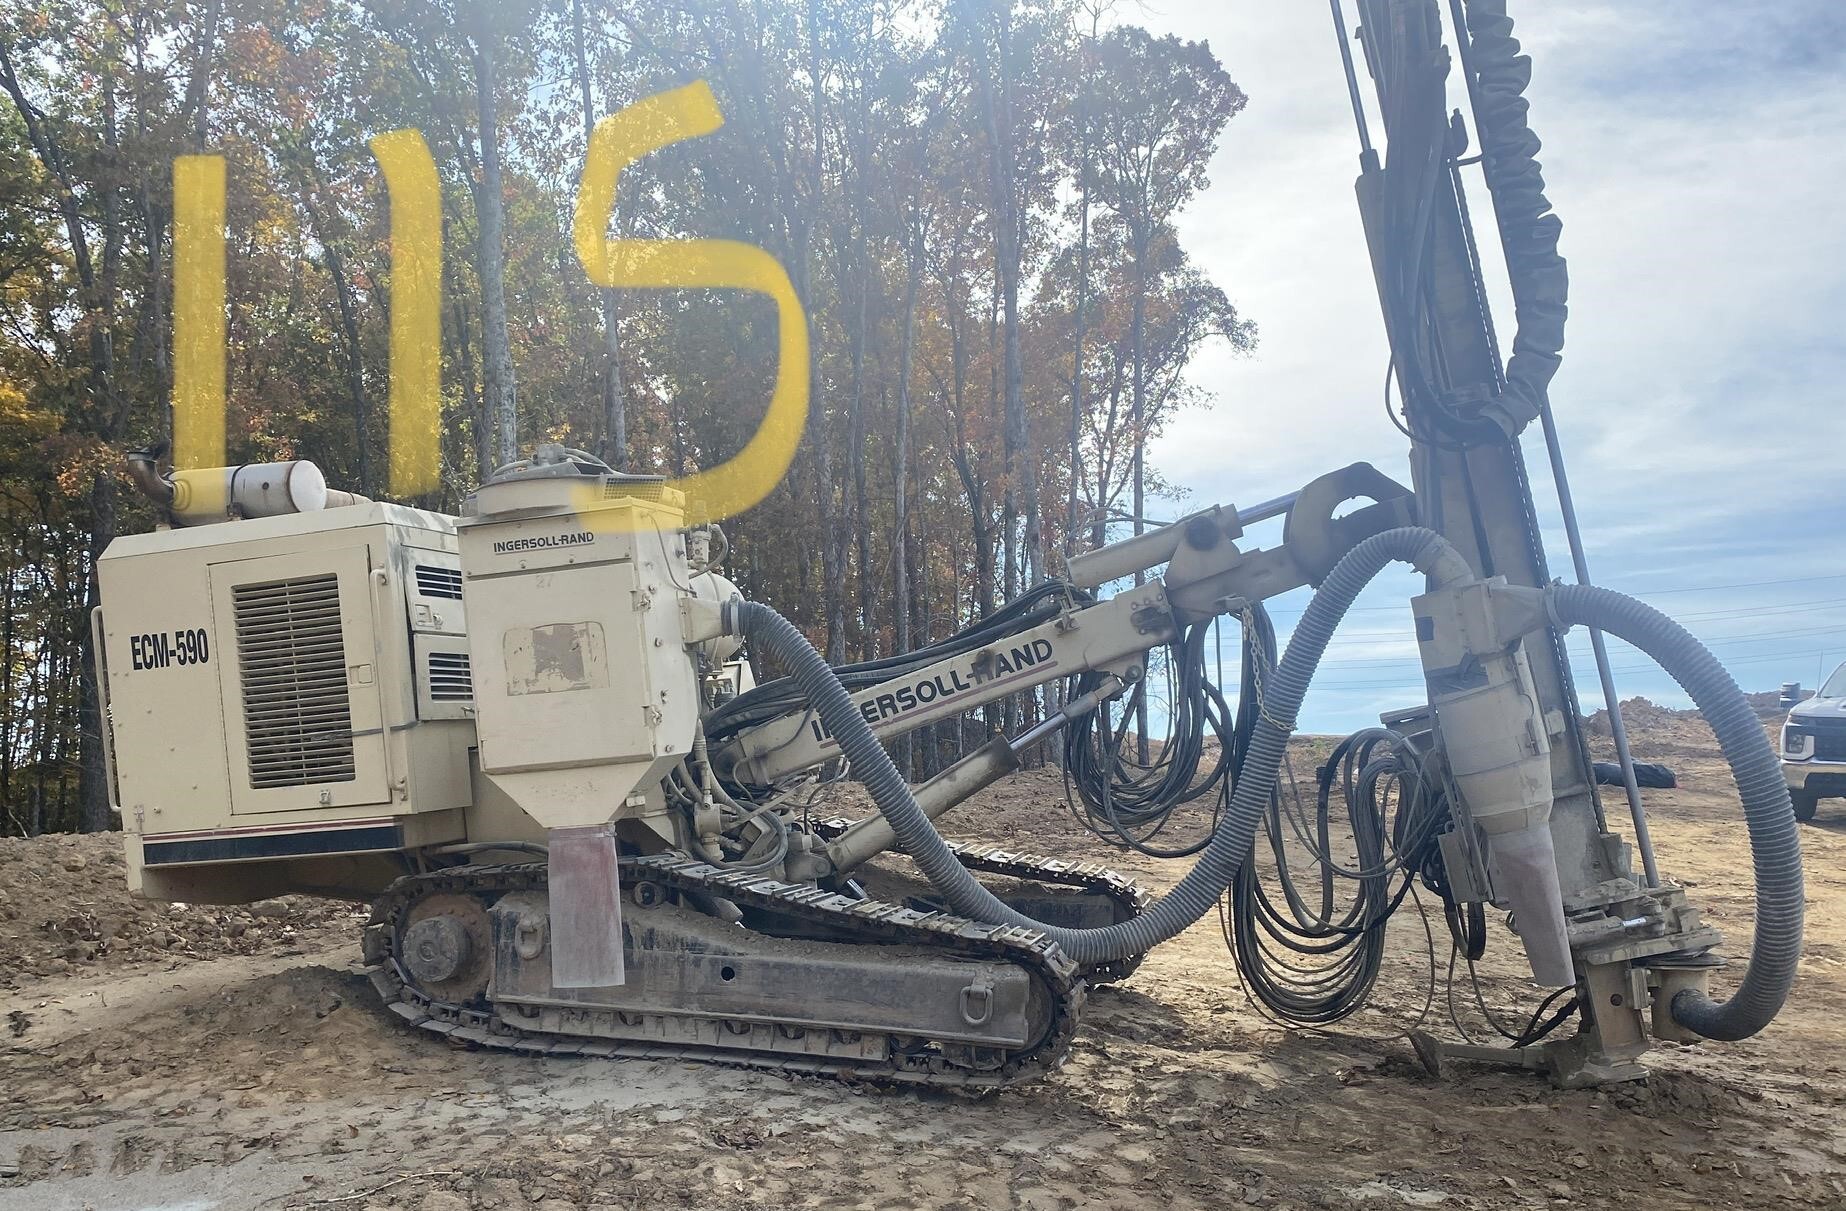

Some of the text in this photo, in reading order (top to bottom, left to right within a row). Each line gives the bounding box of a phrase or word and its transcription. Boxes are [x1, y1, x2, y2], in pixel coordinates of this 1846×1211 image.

[493, 532, 594, 553] INGERSOLL-RAND
[130, 628, 209, 671] ECM-590
[811, 638, 1053, 742] IERSOLL-RAND
